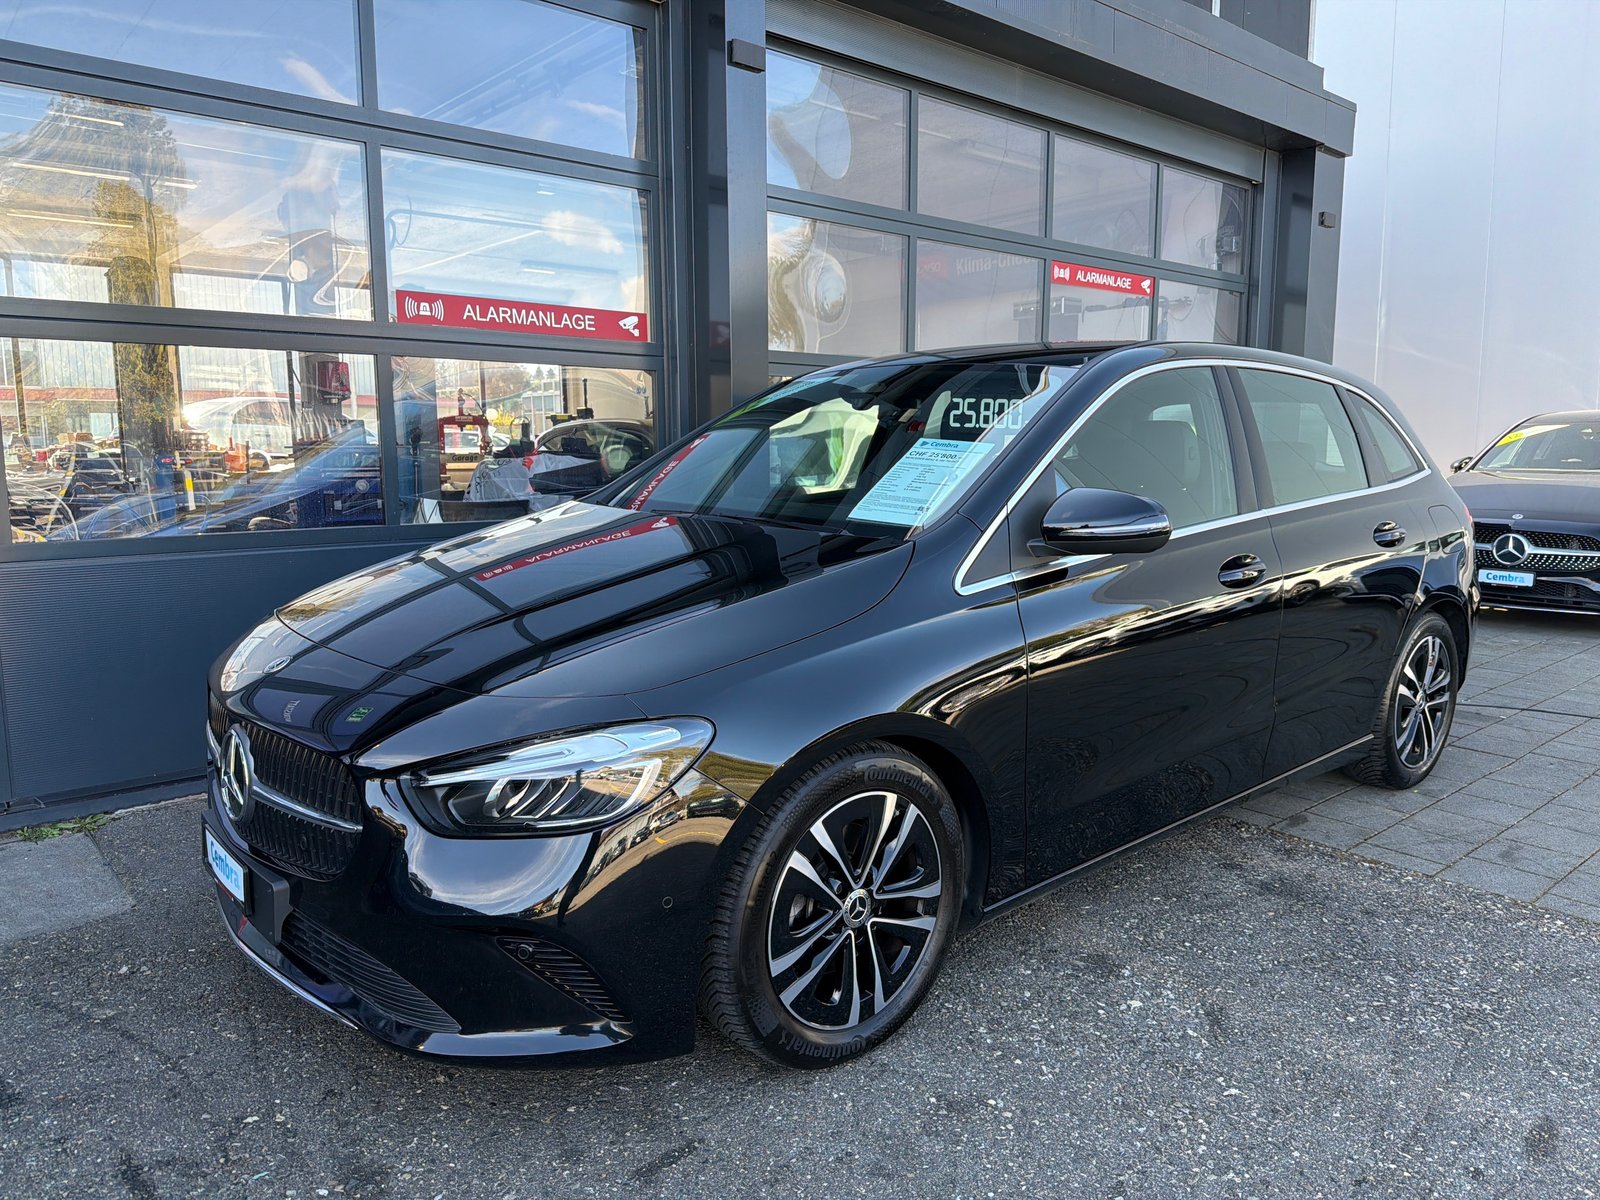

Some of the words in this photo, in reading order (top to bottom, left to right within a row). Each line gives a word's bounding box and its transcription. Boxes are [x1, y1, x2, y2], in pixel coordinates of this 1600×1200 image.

[1076, 269, 1132, 289] ALARMANLAGE
[463, 304, 596, 331] ALARMANLAGE
[930, 441, 959, 449] Cembra
[451, 454, 478, 462] Garage
[1486, 572, 1525, 584] Cembra
[864, 764, 931, 799] Continental
[210, 840, 241, 890] Cembra
[786, 1034, 867, 1061] Continental
